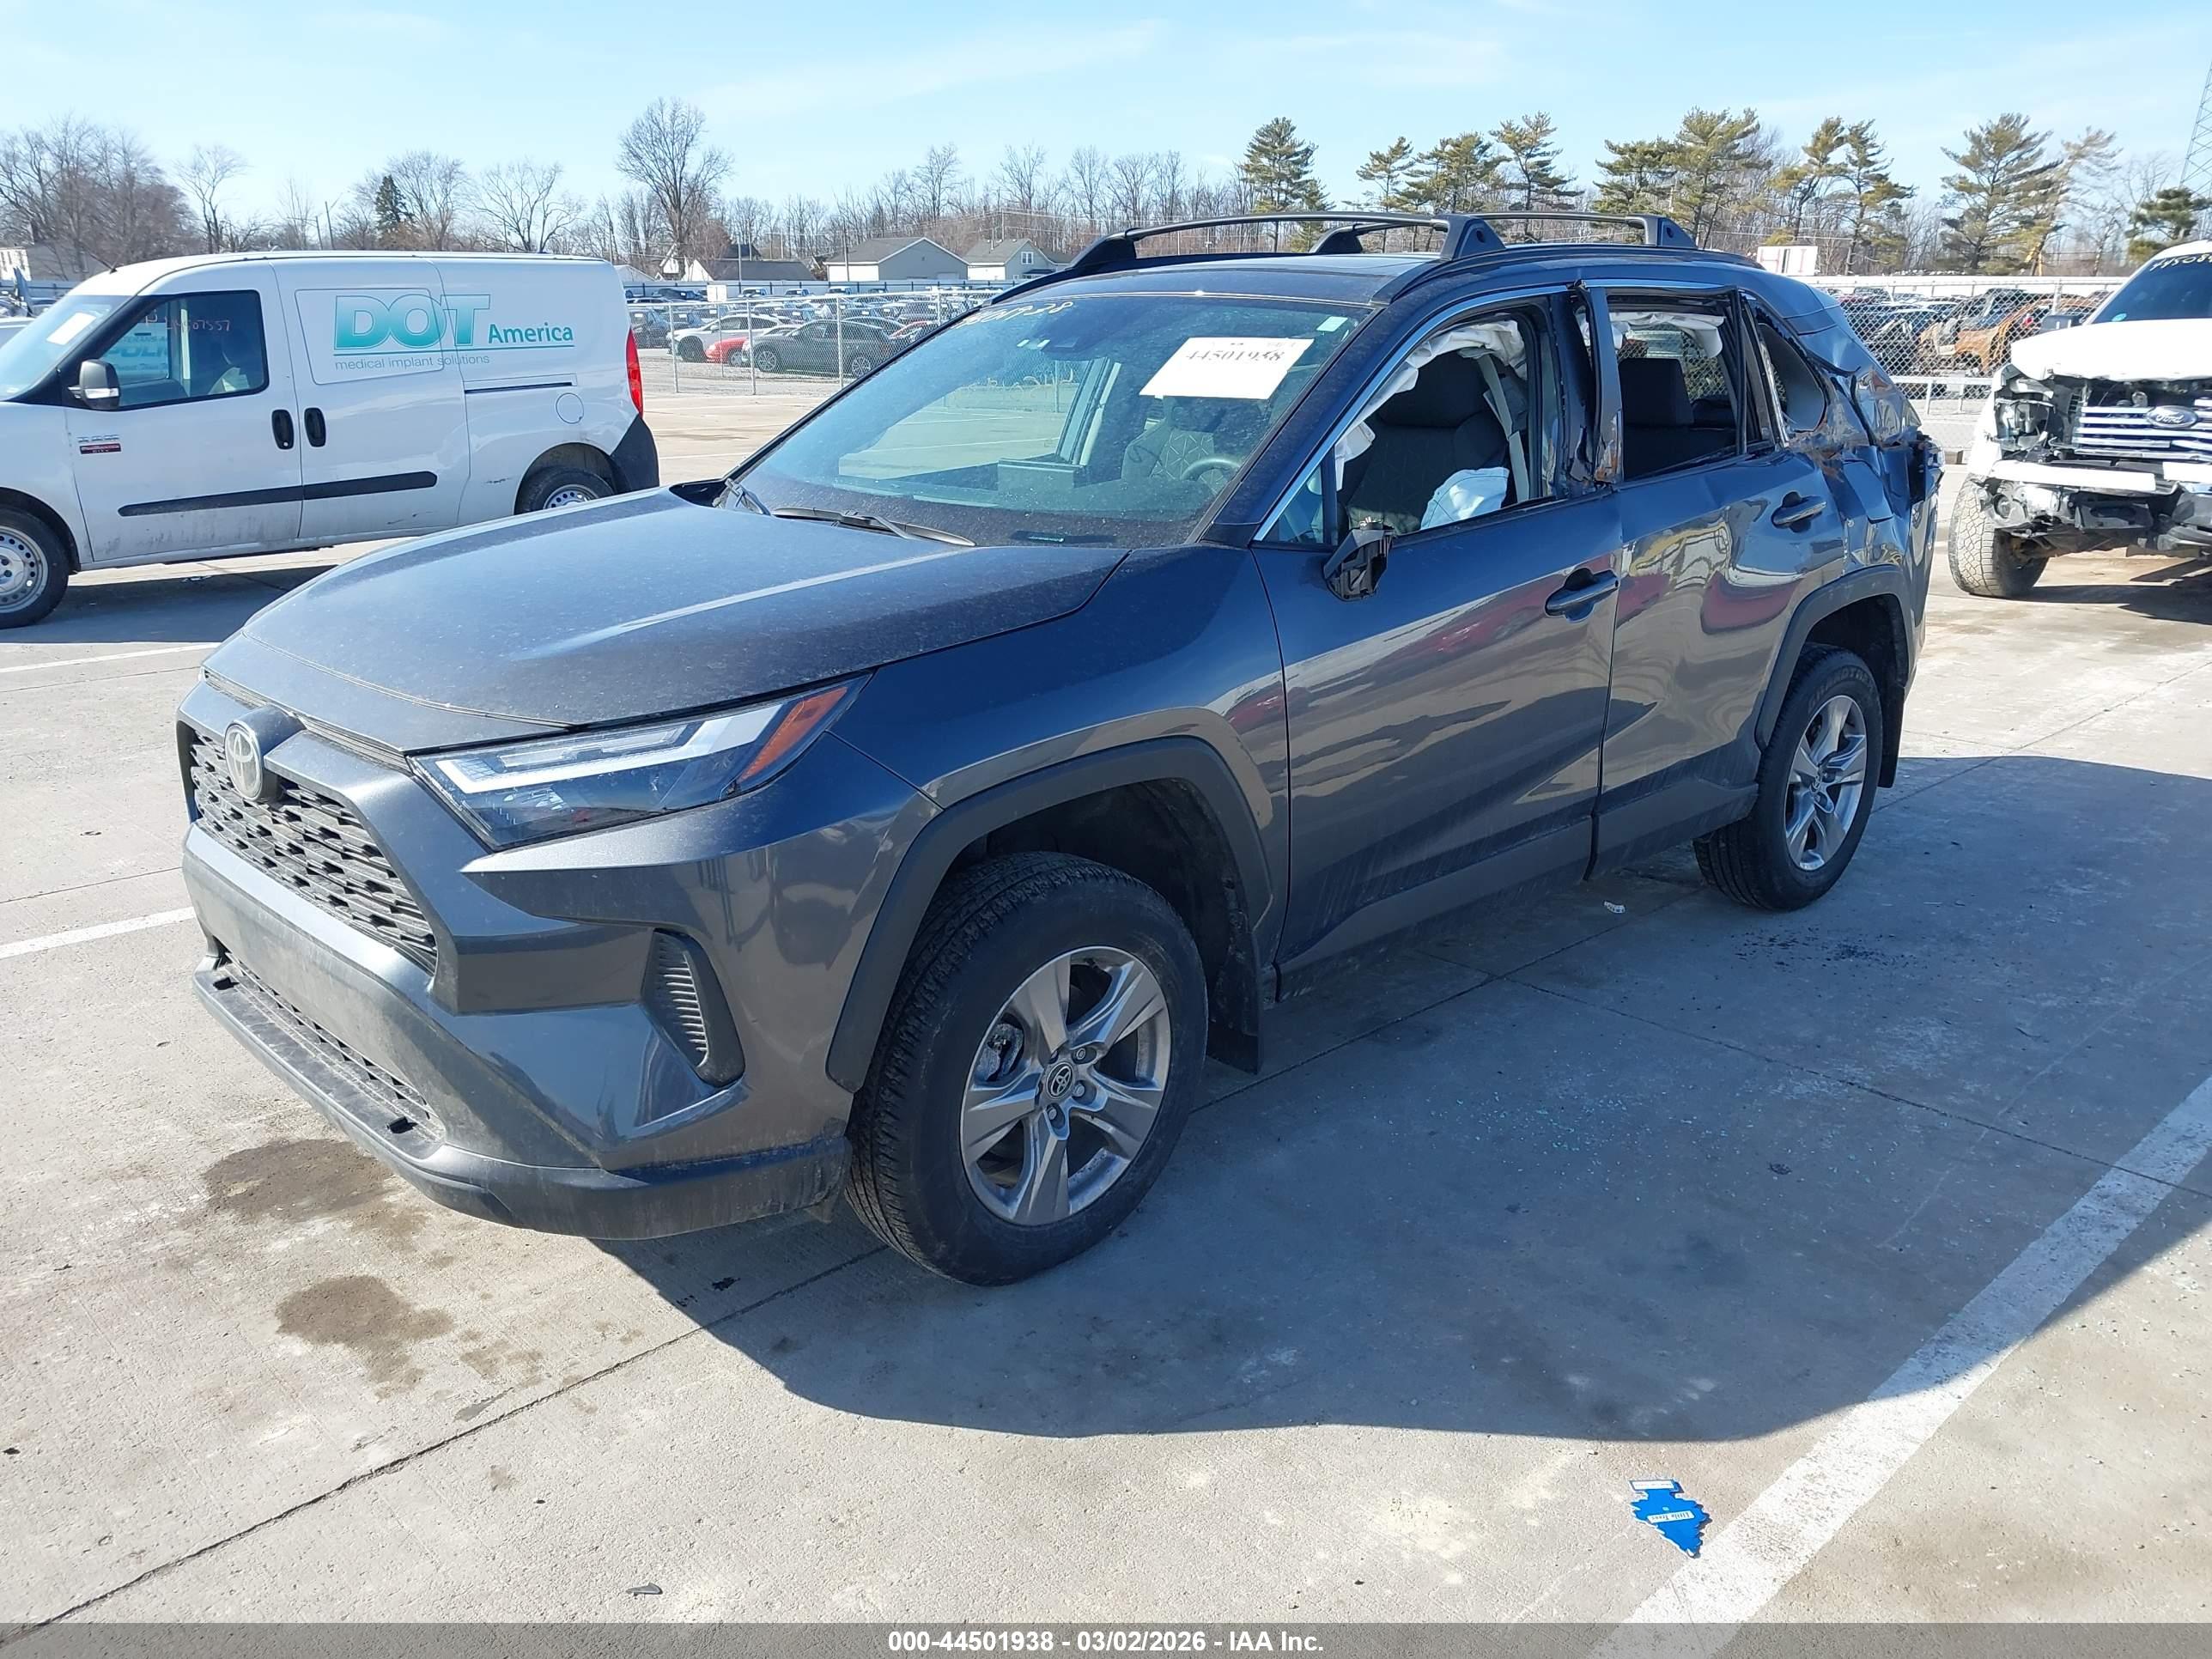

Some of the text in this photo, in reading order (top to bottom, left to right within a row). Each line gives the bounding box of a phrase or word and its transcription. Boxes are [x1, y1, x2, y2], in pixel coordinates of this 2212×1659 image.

[334, 295, 574, 349] DOT America
[335, 353, 491, 371] medical implant solutions
[2156, 414, 2185, 423] Ford
